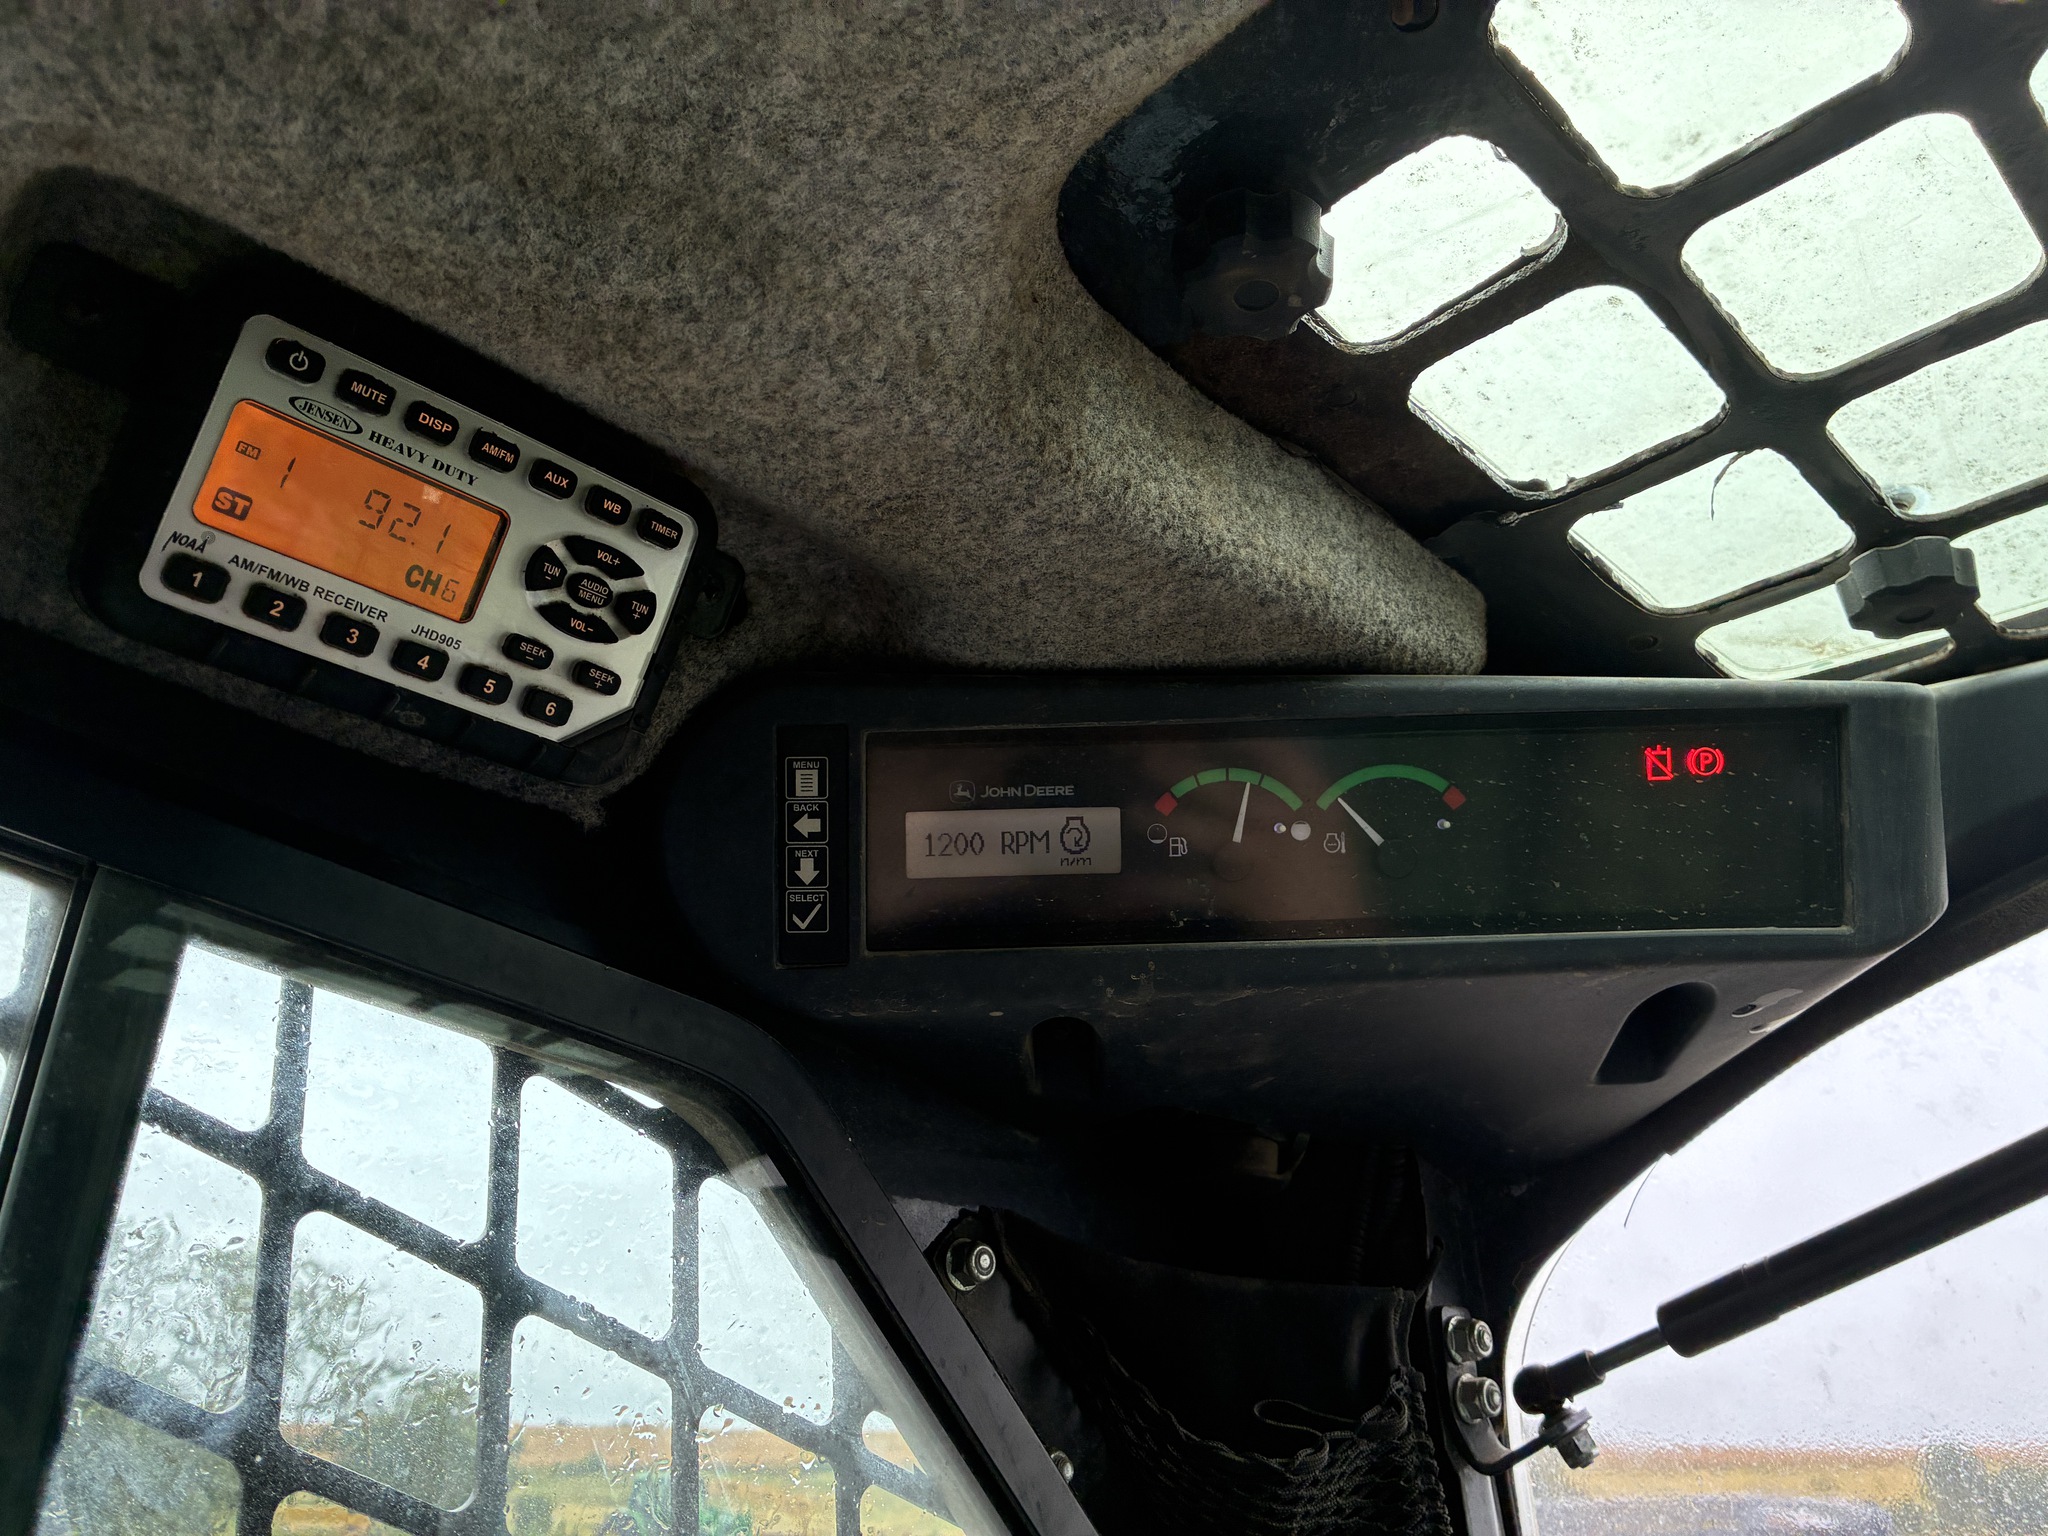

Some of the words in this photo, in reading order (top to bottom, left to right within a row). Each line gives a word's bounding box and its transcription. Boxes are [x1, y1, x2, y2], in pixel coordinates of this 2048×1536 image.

[350, 381, 388, 405] MUTE
[299, 400, 352, 431] JENSEN
[418, 412, 453, 433] DISP
[237, 441, 261, 459] FM
[368, 430, 429, 464] HEAVY
[431, 457, 479, 487] DUTY
[481, 442, 515, 464] AM/FM
[543, 470, 570, 489] AUX
[212, 491, 252, 518] ST
[603, 498, 622, 515] WB
[650, 520, 679, 540] TIMER
[161, 530, 207, 554] NOAA
[597, 549, 620, 566] VOL+
[543, 562, 561, 577] TUN
[192, 571, 203, 588] 1
[228, 553, 311, 593] AM/FM/WB
[312, 585, 389, 623] RECEIVER
[580, 578, 609, 596] AUDIO
[578, 589, 605, 606] MENU
[269, 600, 285, 617] 2
[631, 600, 649, 616] TUN
[346, 628, 359, 645] 3
[410, 623, 462, 651] JHD905
[519, 641, 547, 658] SEEK
[416, 654, 430, 671] 4
[588, 668, 614, 684] SEEK
[483, 678, 496, 694] 5
[545, 701, 557, 717] 6
[792, 760, 820, 769] MENU
[792, 803, 820, 812] BACK
[924, 831, 985, 858] 1200
[1000, 830, 1051, 856] RPM
[794, 849, 819, 858] NEXT
[788, 893, 825, 903] SELECT
